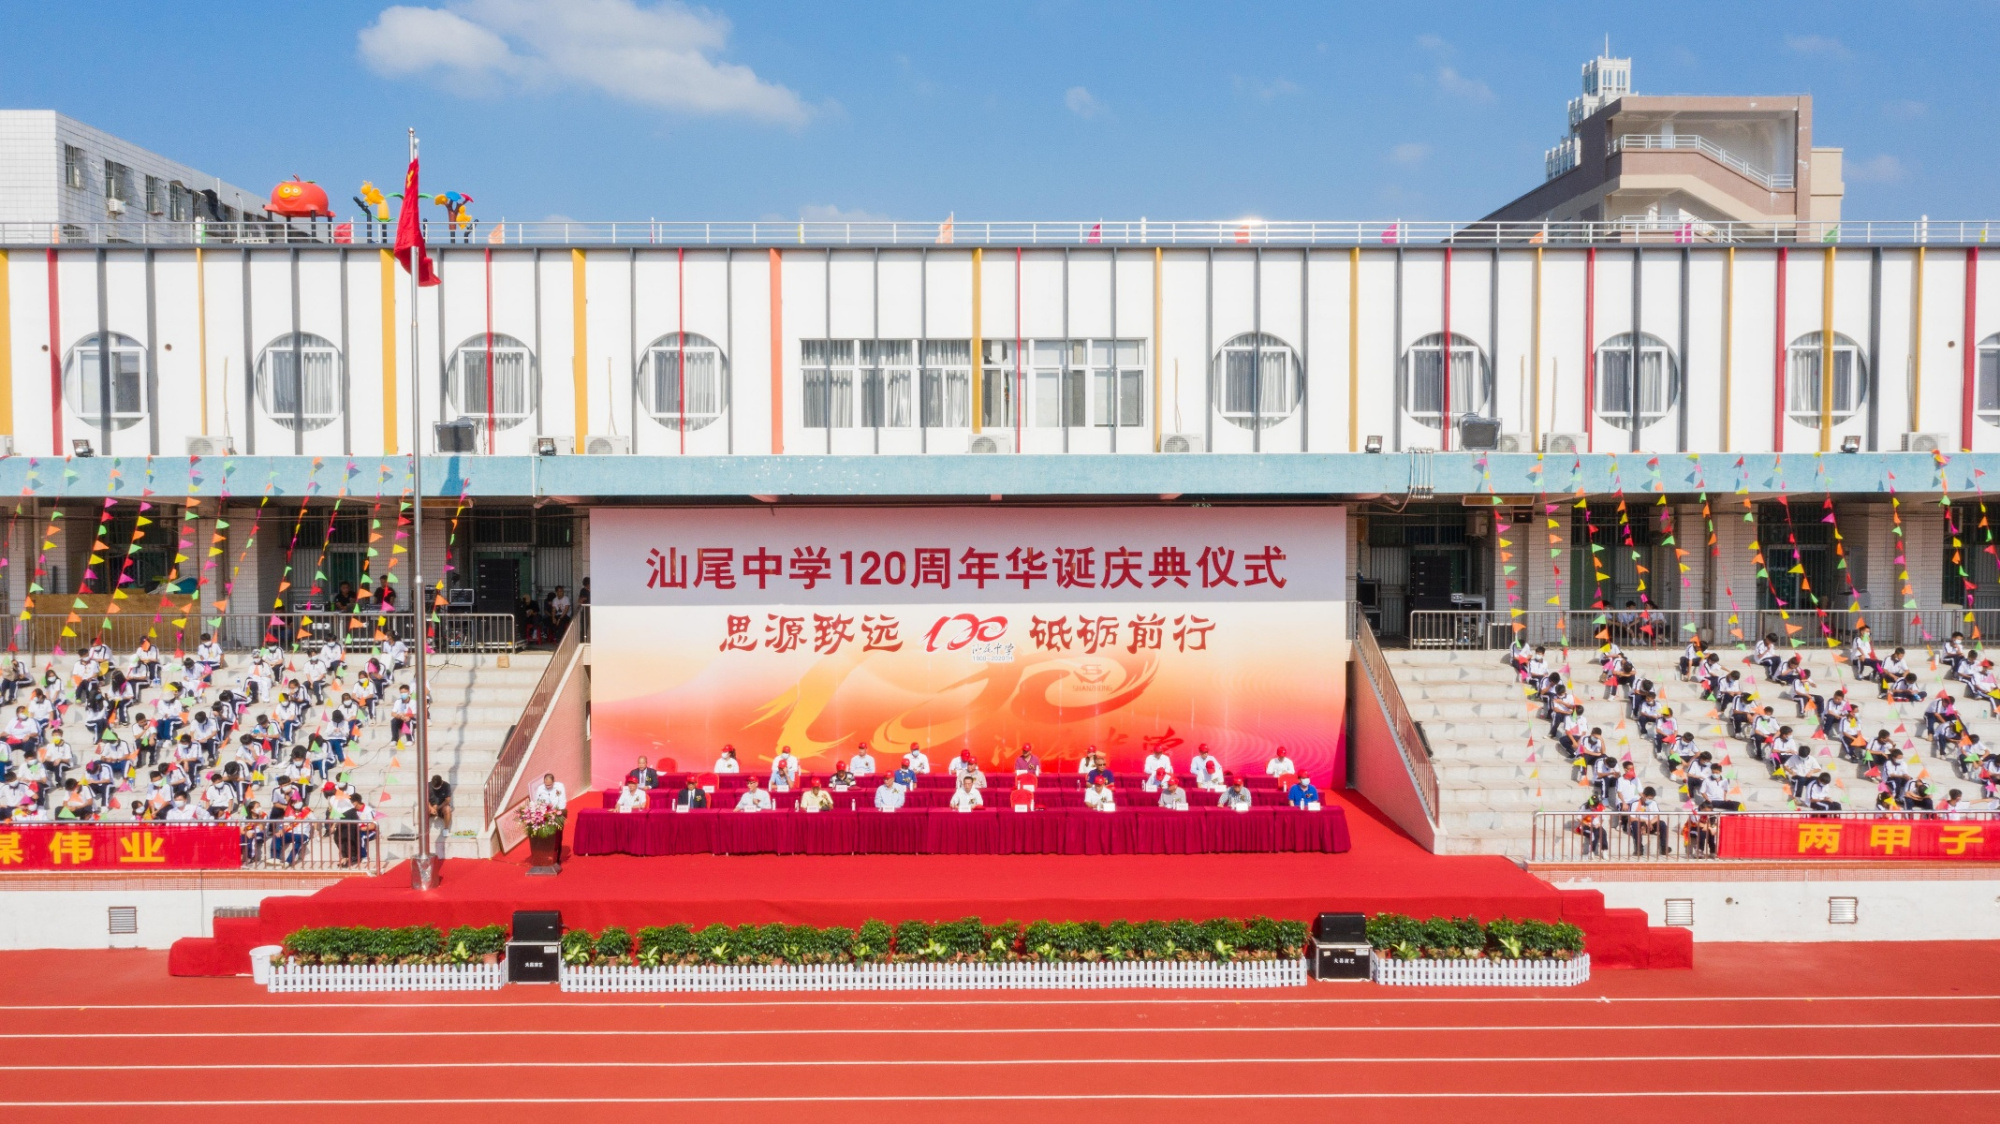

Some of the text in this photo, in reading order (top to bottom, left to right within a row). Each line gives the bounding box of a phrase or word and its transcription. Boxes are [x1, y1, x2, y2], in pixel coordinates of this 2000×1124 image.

[647, 546, 1287, 590] 汕尾中学120周年华诞庆典仪式
[719, 613, 903, 654] 思源致远
[1030, 613, 1216, 654] 砥砺前行
[1797, 823, 1984, 855] 两甲子
